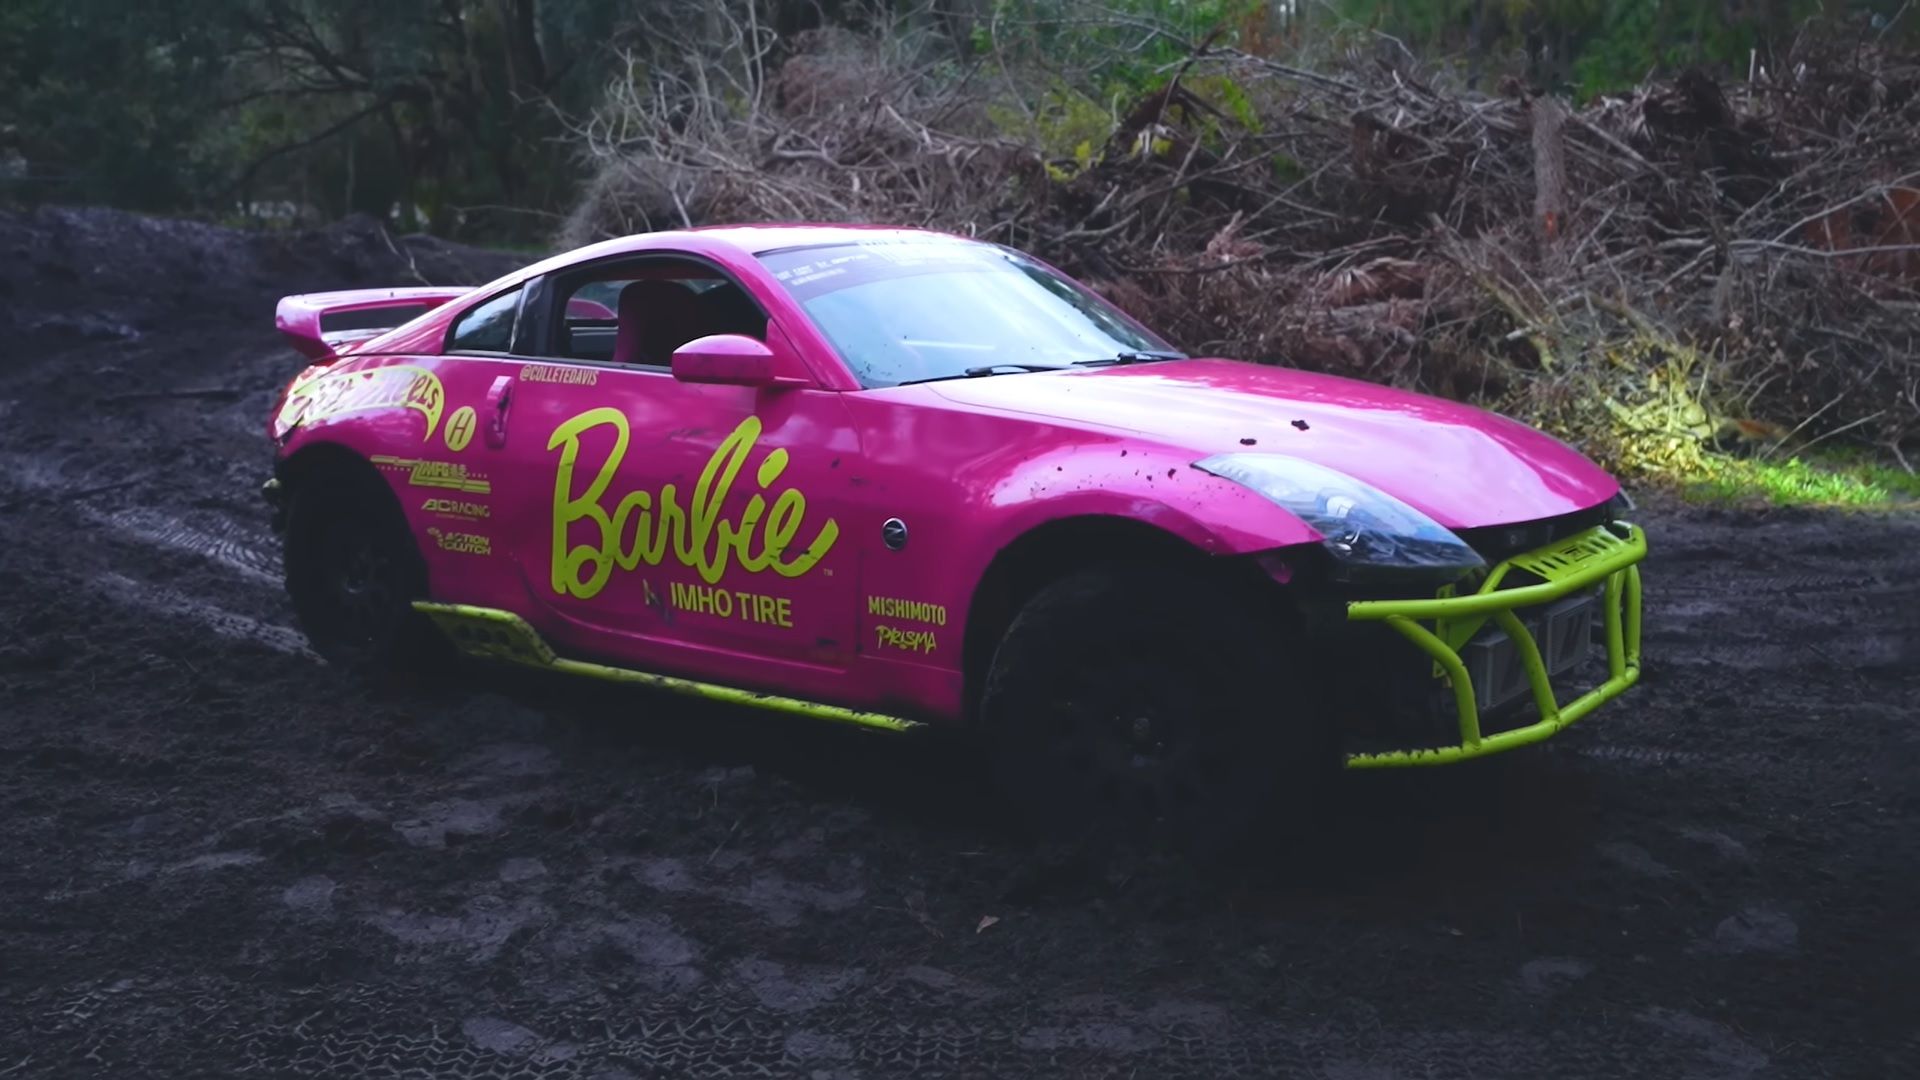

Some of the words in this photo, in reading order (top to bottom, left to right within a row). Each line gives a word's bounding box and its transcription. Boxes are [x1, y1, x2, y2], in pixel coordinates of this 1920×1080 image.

[547, 407, 839, 599] Barbie
[443, 541, 492, 556] CLUTCH
[445, 532, 490, 546] ACTION
[735, 592, 793, 628] TIRE
[868, 595, 947, 626] MISHIMOTO
[875, 625, 937, 655] PRISMA
